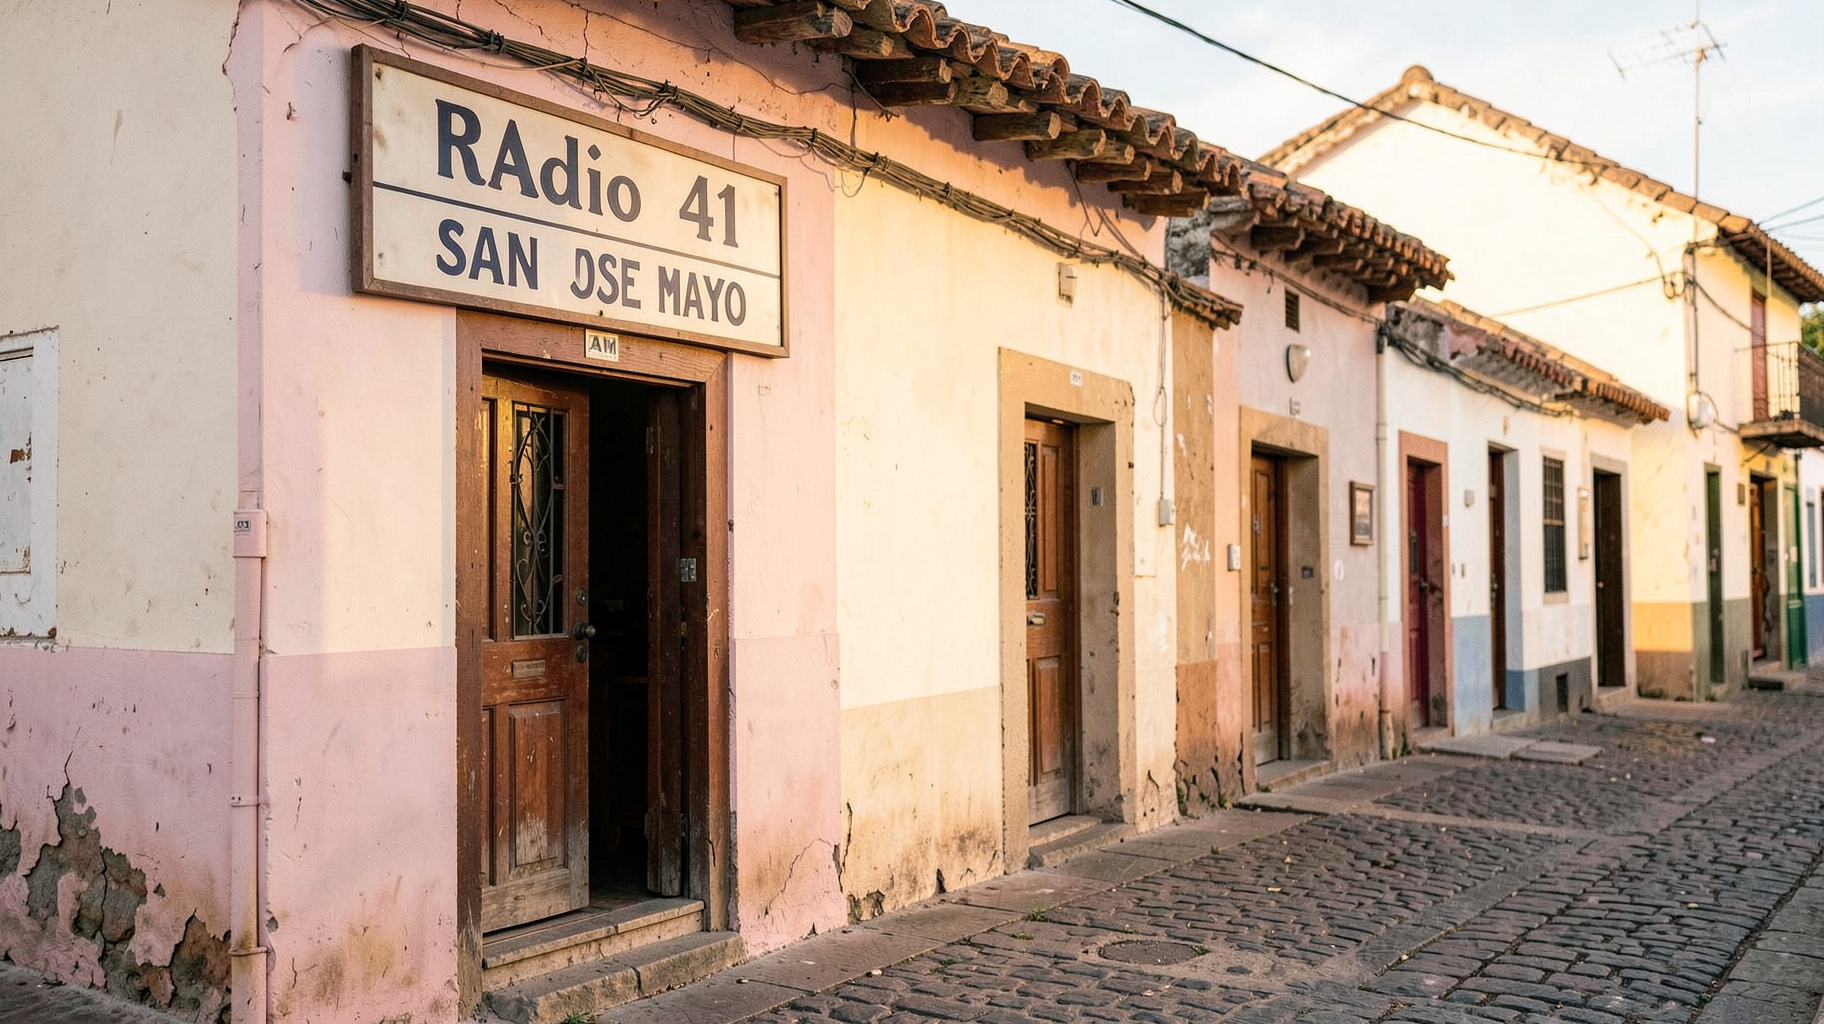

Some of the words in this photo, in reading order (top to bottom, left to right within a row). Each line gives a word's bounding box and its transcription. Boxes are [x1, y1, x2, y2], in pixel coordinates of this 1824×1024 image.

[435, 98, 642, 223] RAdio
[678, 174, 739, 249] 41
[435, 218, 539, 291] SAN
[657, 265, 747, 327] MAYO
